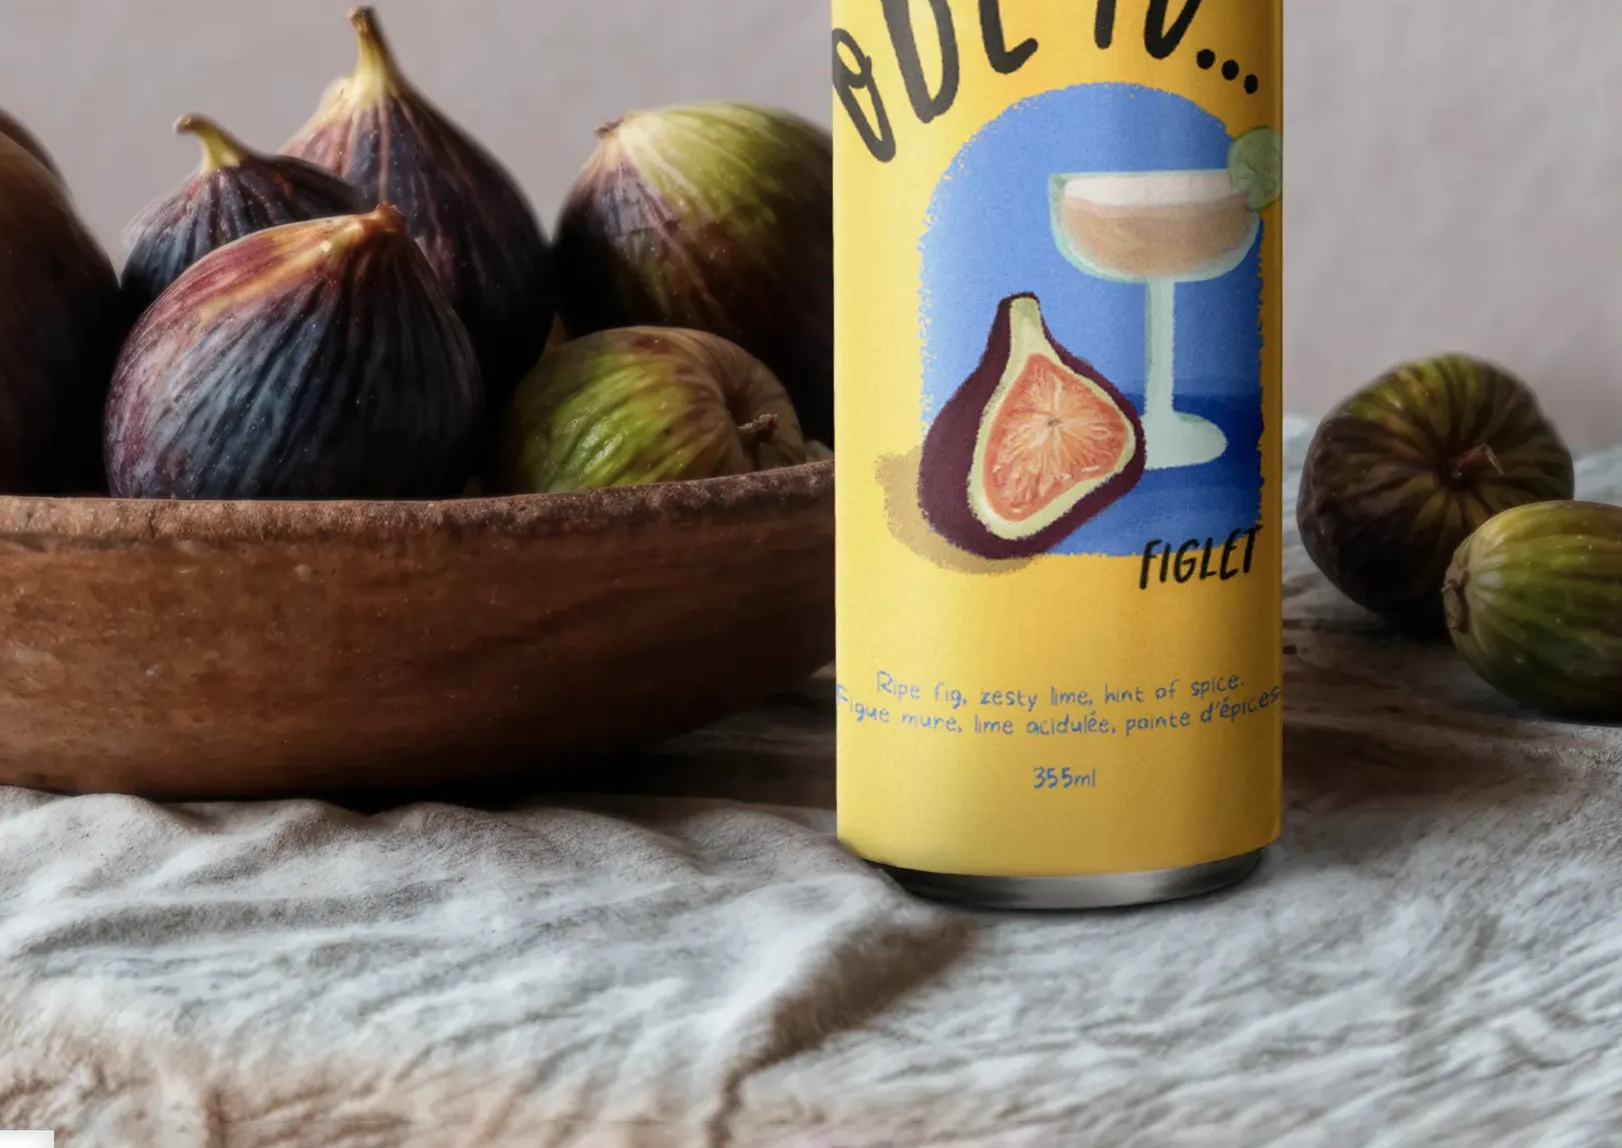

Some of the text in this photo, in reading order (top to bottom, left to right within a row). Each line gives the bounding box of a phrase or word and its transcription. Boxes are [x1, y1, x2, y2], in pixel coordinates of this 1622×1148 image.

[1139, 524, 1263, 590] FIGLET
[877, 670, 1244, 712] Ripe fig, zesty lime, hint of spice.
[974, 714, 1014, 735] lime
[1026, 710, 1116, 735] acidulée,
[1126, 710, 1191, 737] pointe
[1033, 765, 1096, 789] 355ml
